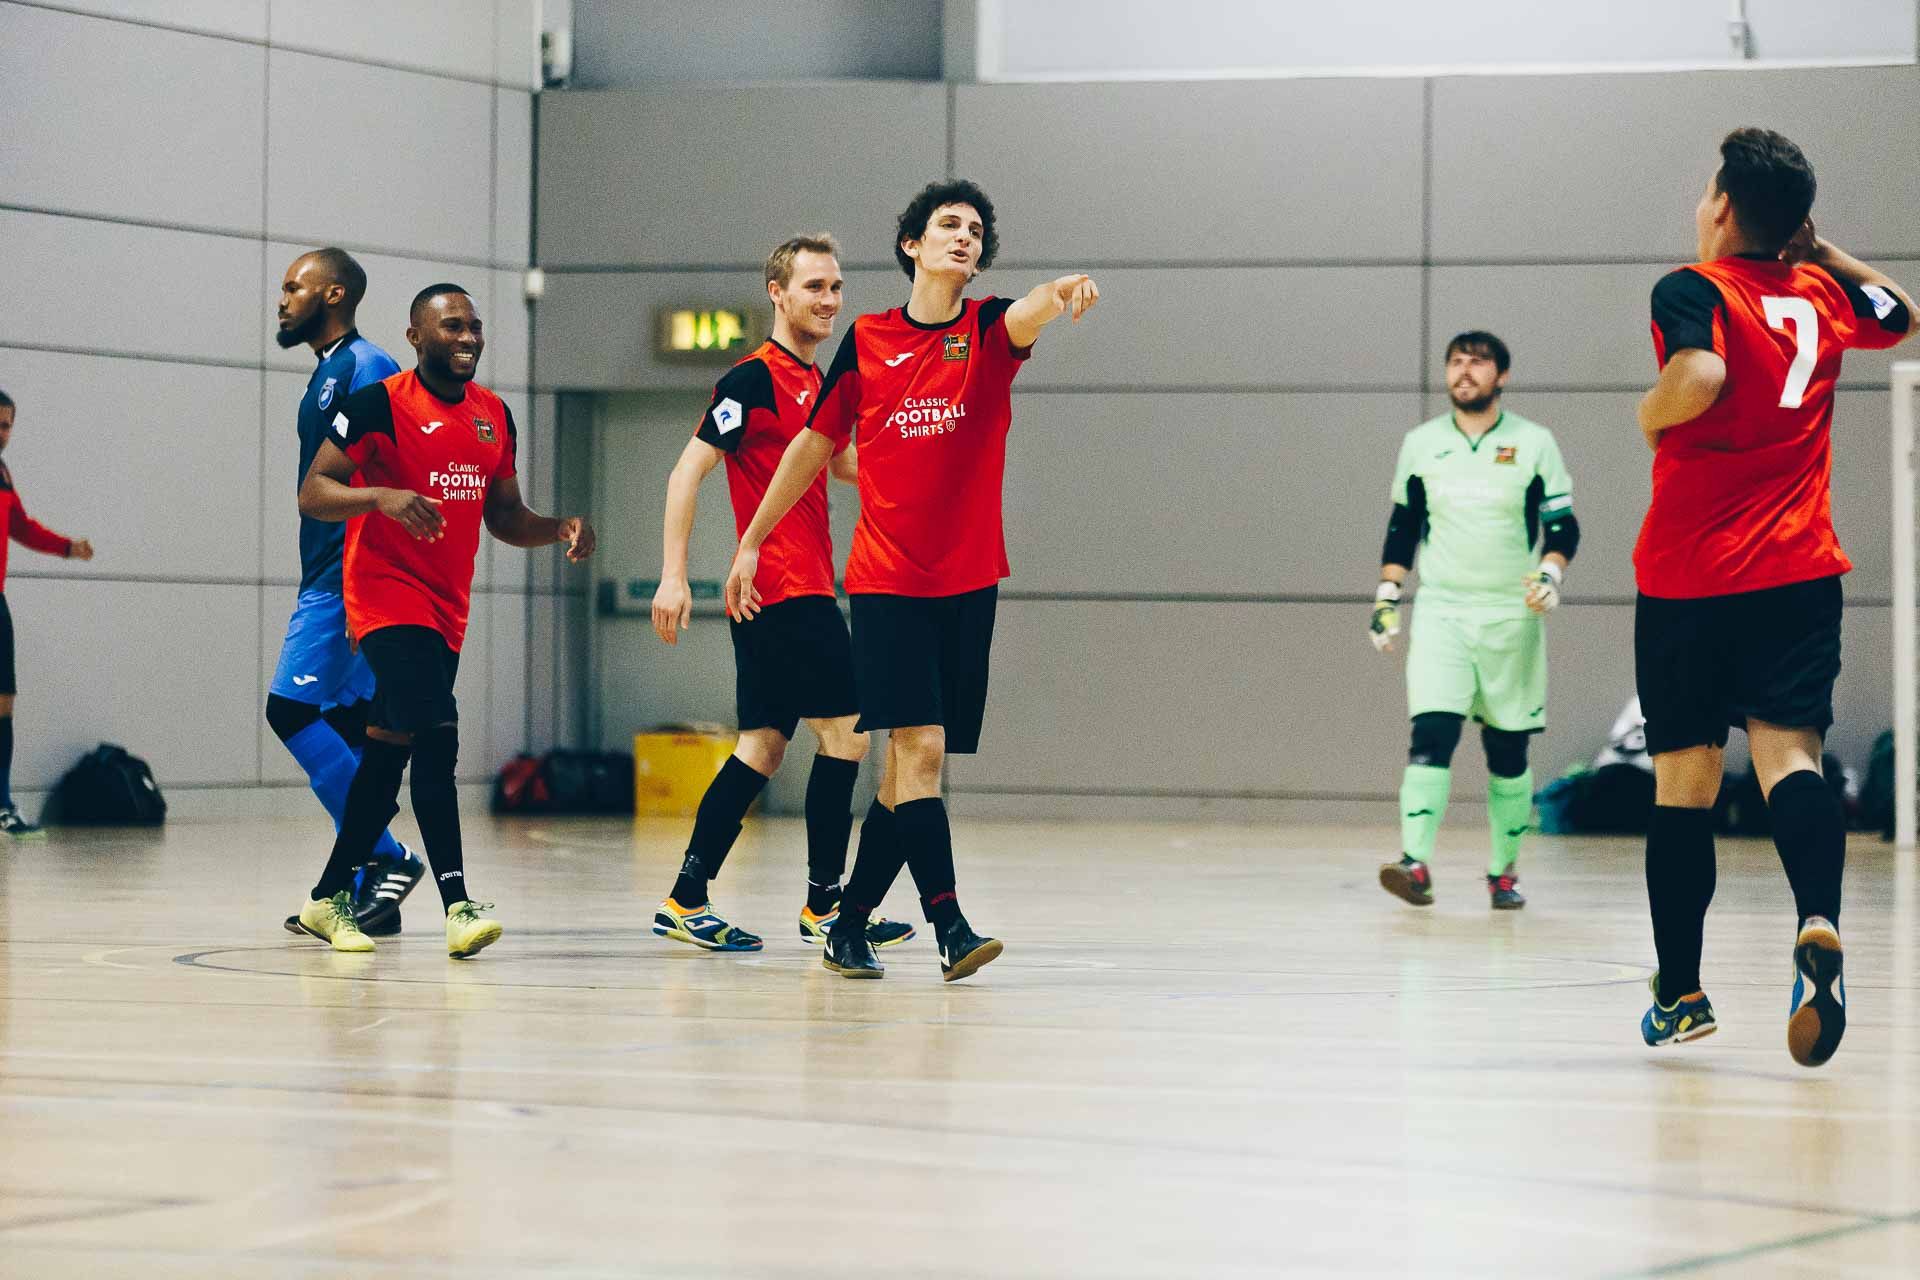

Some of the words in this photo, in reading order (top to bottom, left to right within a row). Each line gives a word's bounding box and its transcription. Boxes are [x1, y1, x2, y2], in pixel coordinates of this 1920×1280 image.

[1760, 295, 1819, 409] 7
[904, 397, 949, 409] CLASSIC
[900, 423, 944, 439] SHIRTS
[448, 461, 480, 473] CLASSIC
[442, 487, 477, 501] SHIRTS
